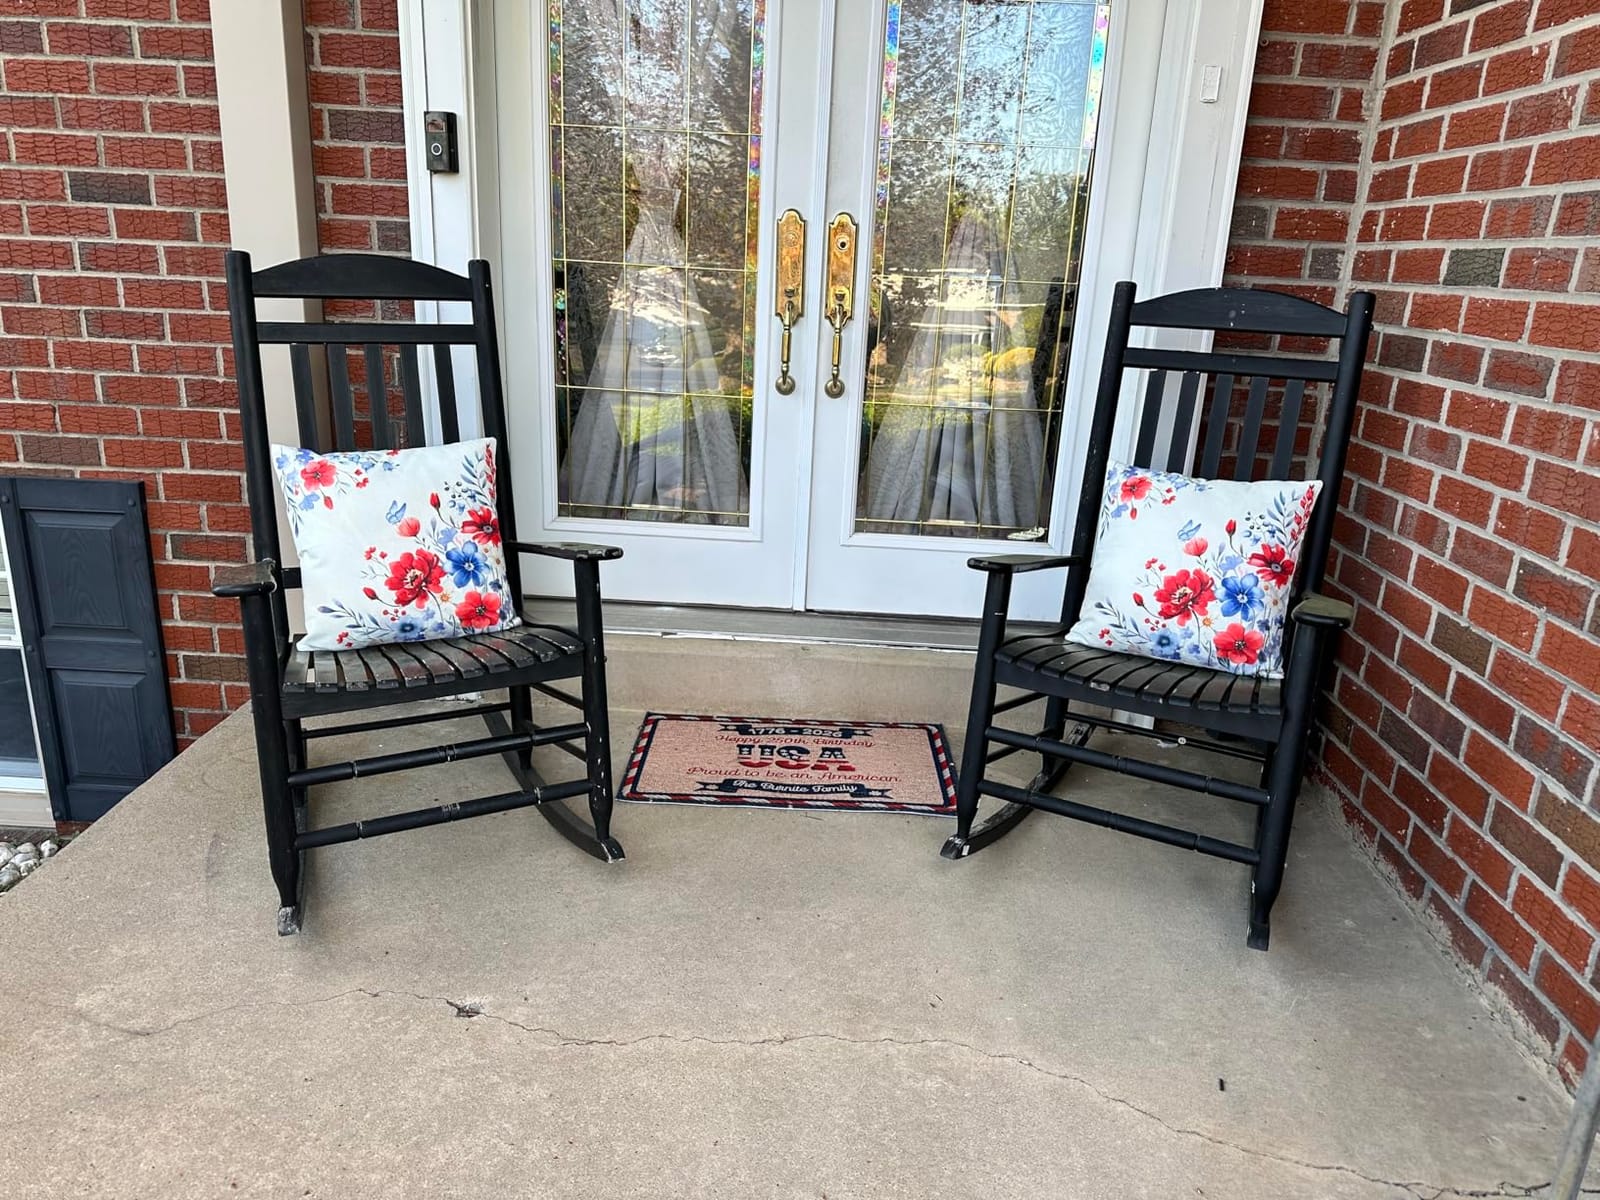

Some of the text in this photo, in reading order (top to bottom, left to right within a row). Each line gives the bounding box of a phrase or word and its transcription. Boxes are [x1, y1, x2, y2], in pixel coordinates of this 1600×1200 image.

[802, 728, 842, 738] 2026
[715, 735, 876, 748] Happy 250th Birthday
[736, 744, 856, 771] USA
[686, 766, 740, 776] Proud
[744, 769, 760, 777] to
[766, 769, 787, 778] be
[818, 772, 901, 782] American
[732, 779, 758, 788] The
[811, 784, 858, 793] Family
